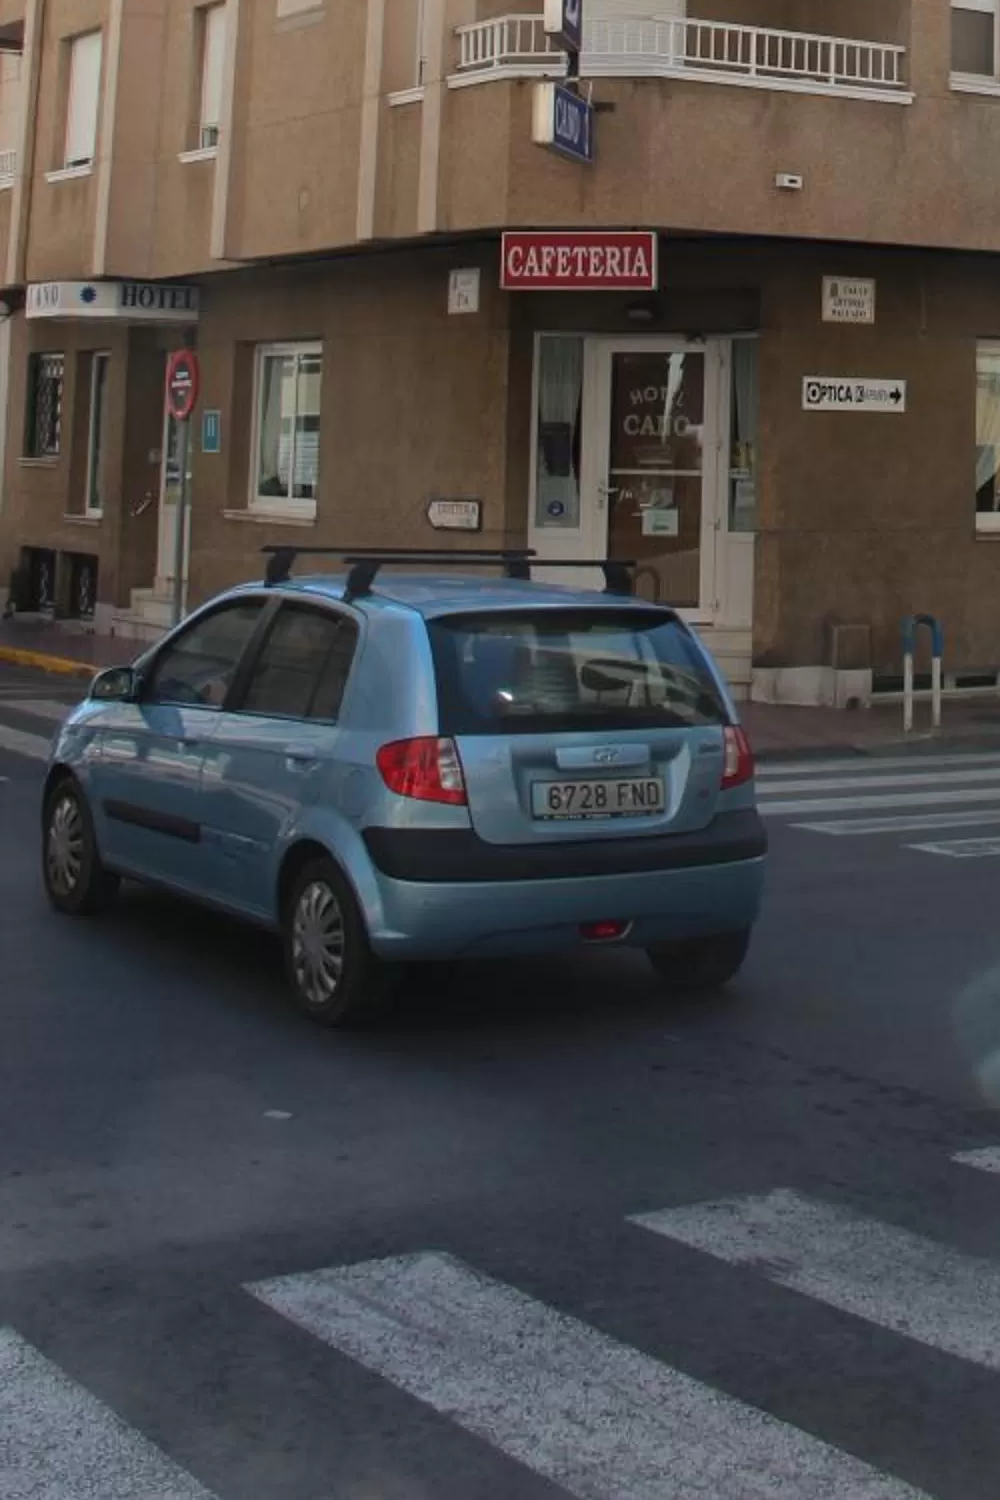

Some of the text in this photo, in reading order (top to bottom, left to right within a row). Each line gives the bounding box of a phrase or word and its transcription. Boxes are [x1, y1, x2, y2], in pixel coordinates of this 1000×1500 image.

[507, 245, 649, 277] CAFETERIA
[121, 283, 196, 311] HOTEL
[629, 386, 685, 408] HOTL
[549, 781, 660, 810] 6728 FND
